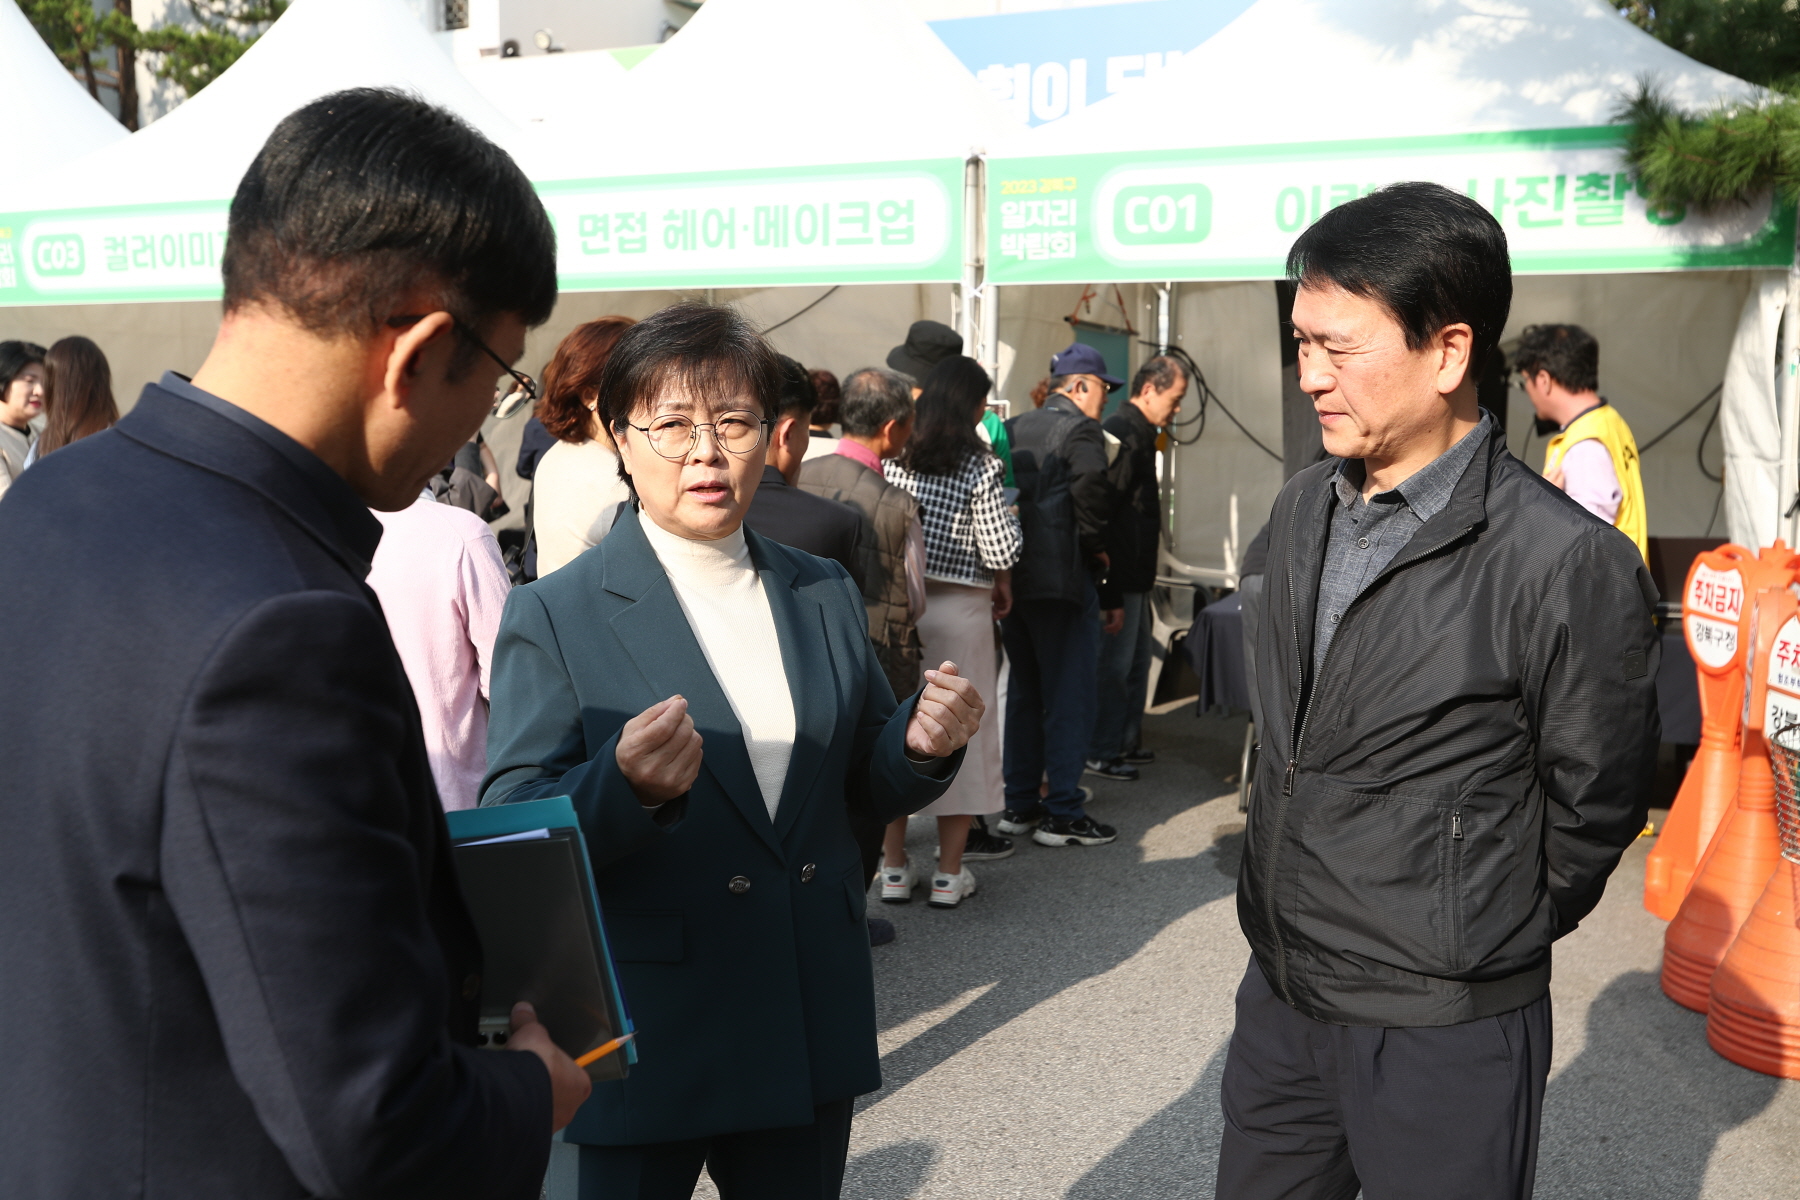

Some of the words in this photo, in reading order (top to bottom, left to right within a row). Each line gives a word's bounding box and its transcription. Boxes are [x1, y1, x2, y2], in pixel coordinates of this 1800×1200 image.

[1001, 180, 1037, 195] 2023
[578, 211, 648, 255] 면접
[662, 199, 915, 252] 헤어·메이크업
[1001, 199, 1077, 229] 일자리
[1124, 194, 1197, 234] C01
[37, 239, 81, 270] C03
[1001, 231, 1077, 261] 박람회
[1694, 579, 1742, 616] 주차금지
[1695, 621, 1736, 652] 강북구청
